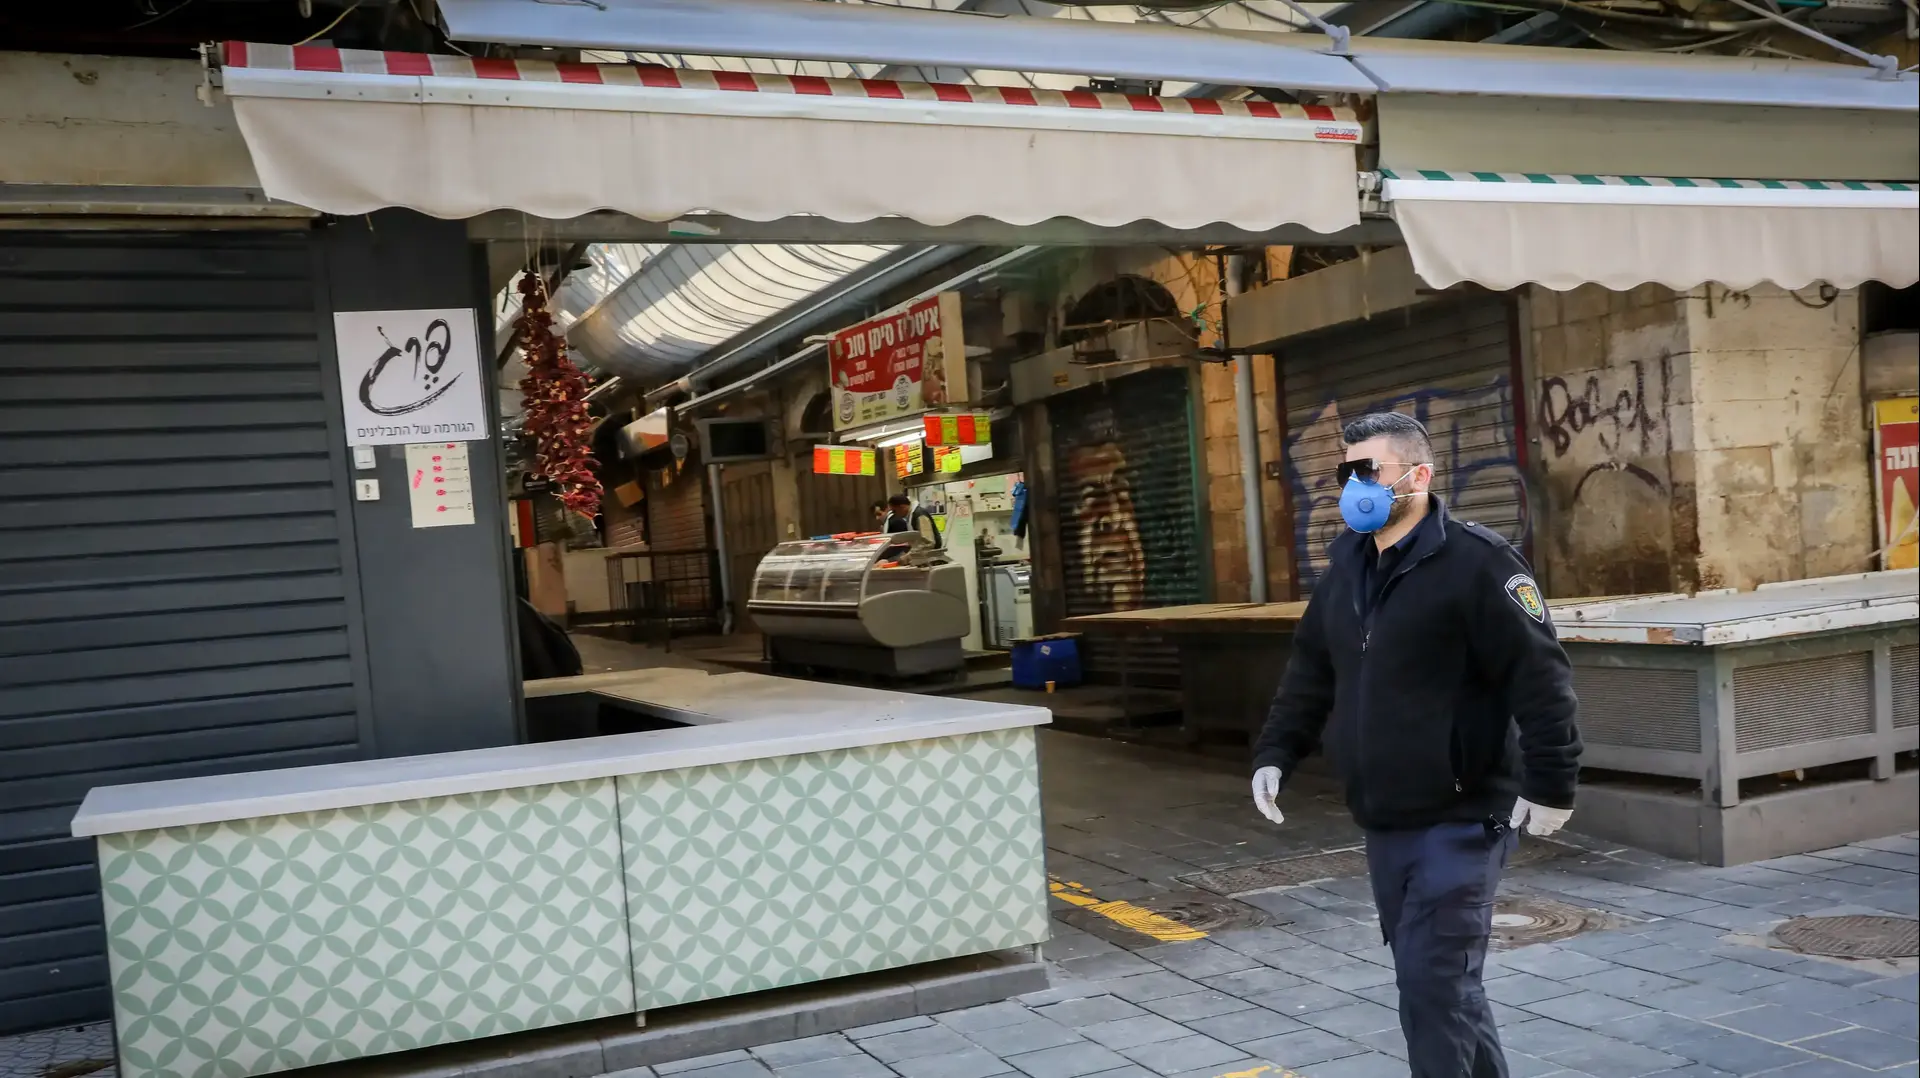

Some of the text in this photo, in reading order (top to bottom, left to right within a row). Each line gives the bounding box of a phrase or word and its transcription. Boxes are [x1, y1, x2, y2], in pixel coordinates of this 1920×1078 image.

[846, 332, 866, 360] טוב
[868, 323, 894, 358] סימן
[357, 421, 475, 438] הגורמה של התבלינים
[1885, 445, 1919, 471] ונה
